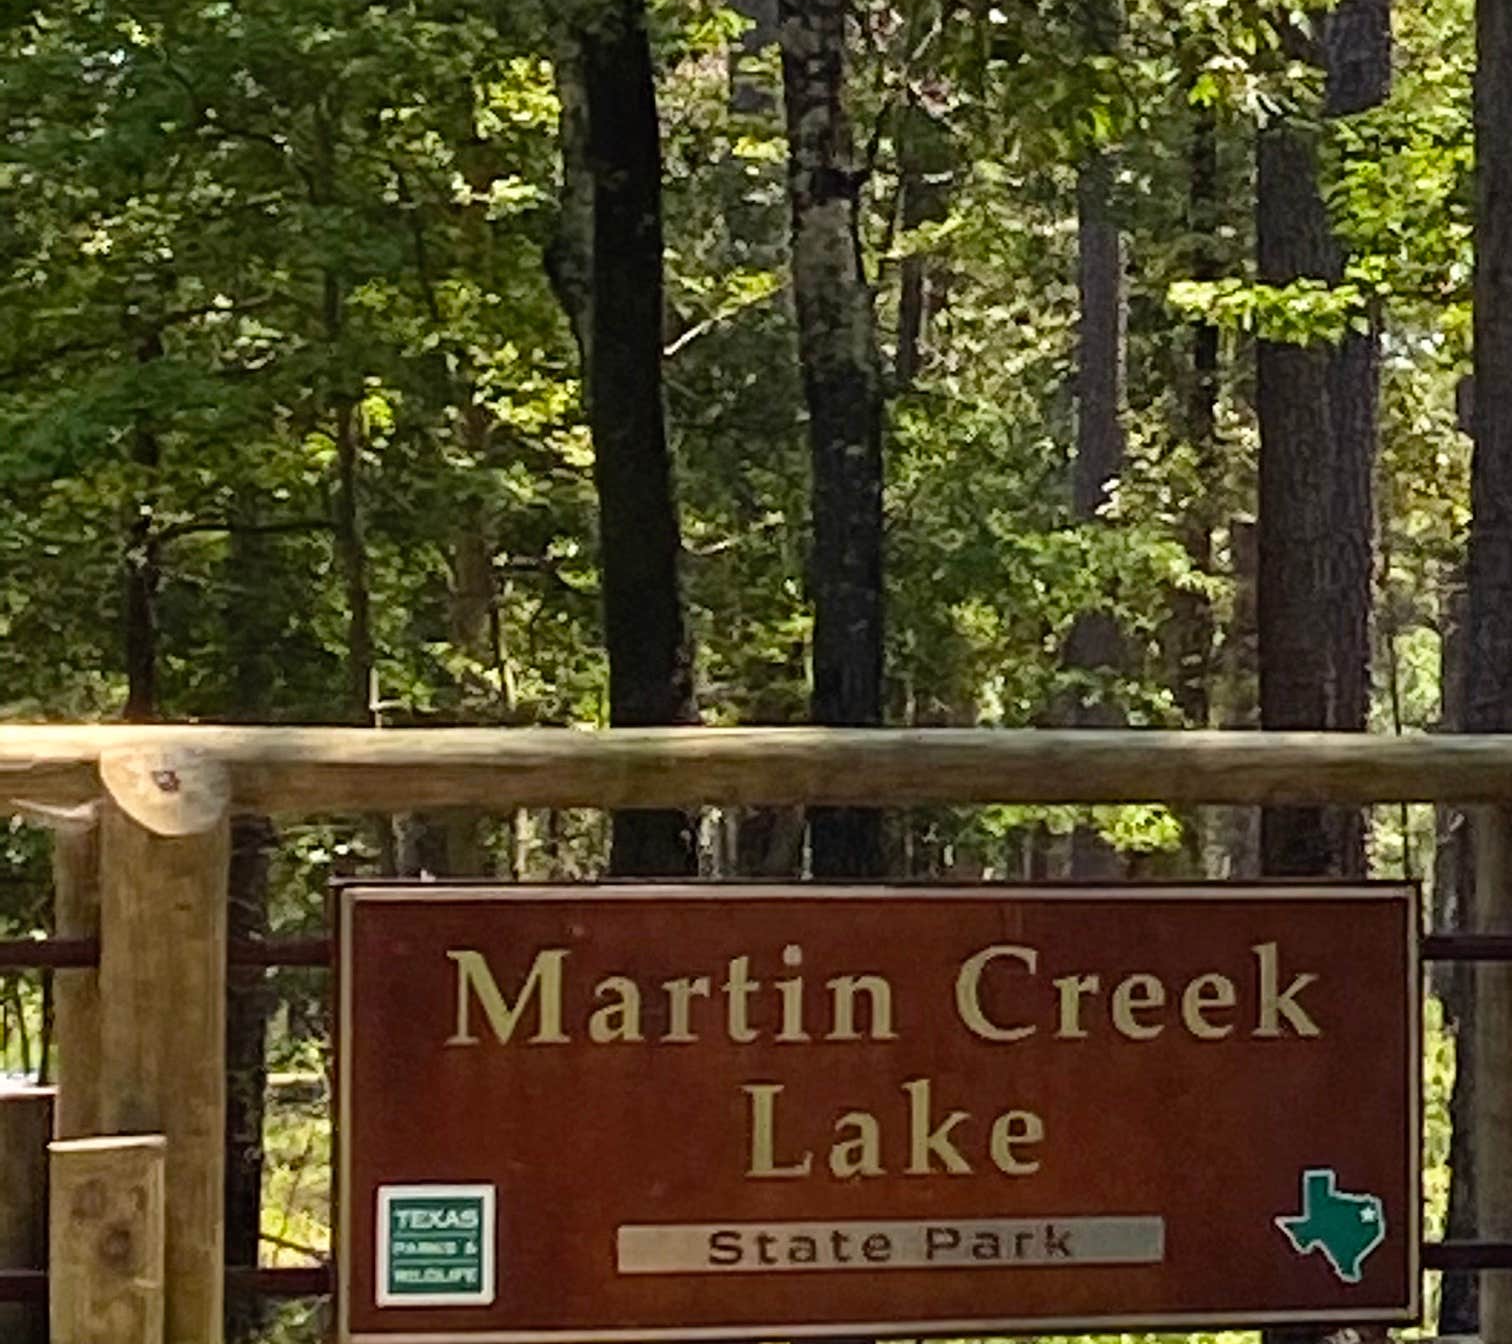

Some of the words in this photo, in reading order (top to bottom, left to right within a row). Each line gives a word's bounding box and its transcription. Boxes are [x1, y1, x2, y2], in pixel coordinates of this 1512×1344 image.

[444, 944, 899, 1045] Martin
[955, 942, 1321, 1042] Creek
[741, 1078, 1045, 1179] Lake
[393, 1208, 479, 1229] TEXAS
[708, 1229, 893, 1266] State
[925, 1223, 1075, 1261] Park
